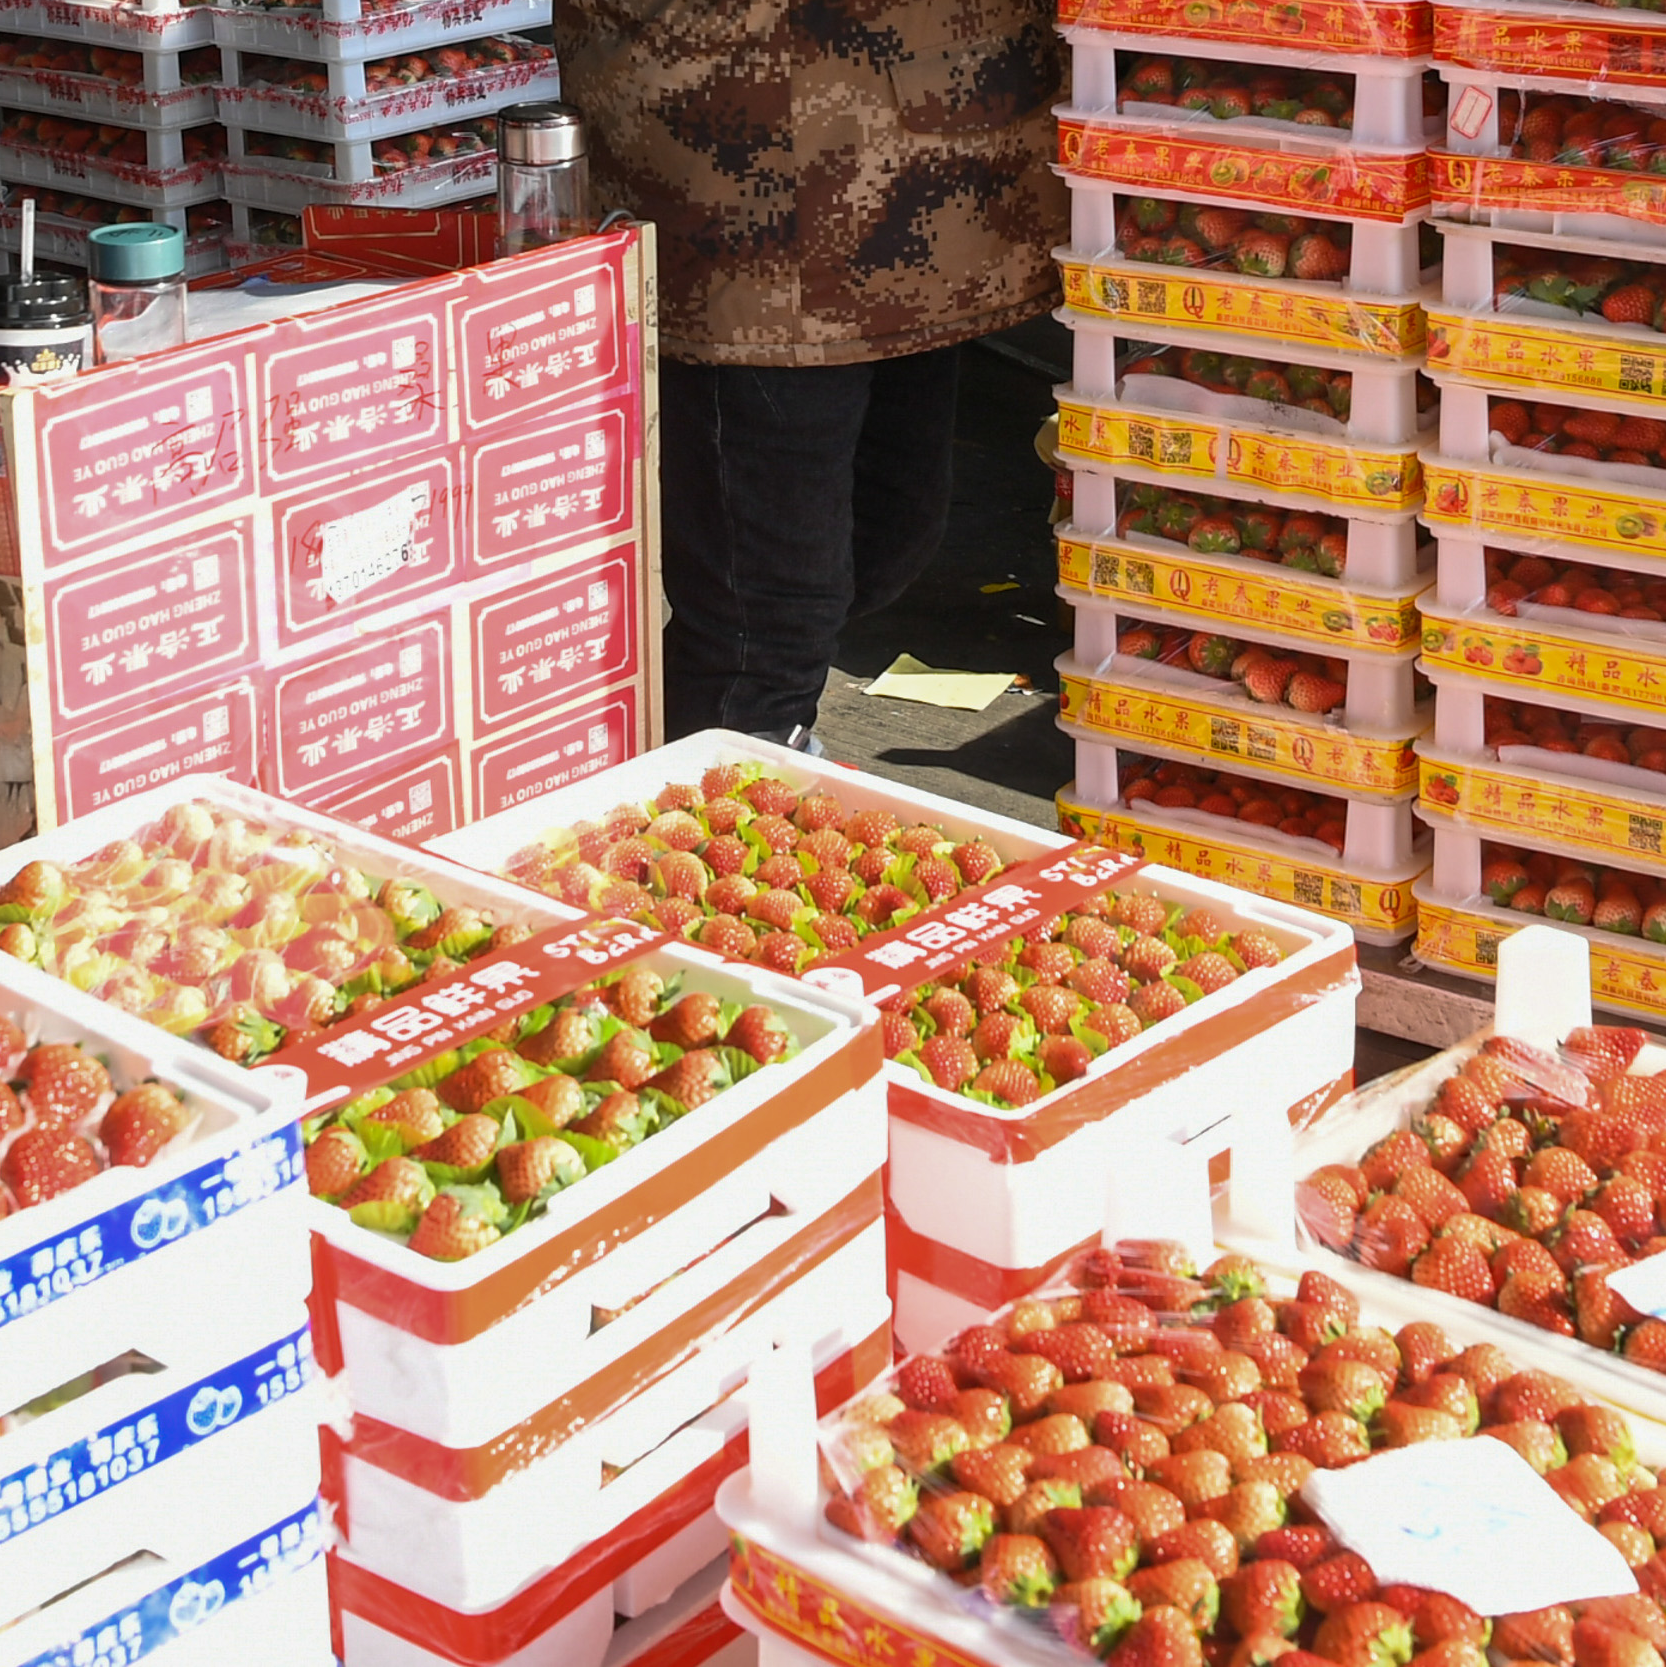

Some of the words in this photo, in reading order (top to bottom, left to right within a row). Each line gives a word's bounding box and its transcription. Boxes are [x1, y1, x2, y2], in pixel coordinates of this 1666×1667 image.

[1182, 286, 1205, 320] Q
[531, 329, 555, 352] HAO
[557, 316, 596, 344] ZHENG
[1470, 334, 1595, 371] 精品水果
[310, 390, 340, 413] GUO
[343, 382, 369, 404] HAO
[74, 461, 92, 482] YE
[95, 448, 130, 475] GUO
[567, 462, 605, 487] ZHENG
[495, 487, 509, 506] YE
[511, 479, 539, 502] GUO
[541, 473, 565, 494] HAO
[492, 486, 606, 538] 正浩果业
[1481, 487, 1606, 521] 老秦果业
[172, 587, 220, 620] ZHENG
[1169, 569, 1191, 602] Q
[1202, 577, 1314, 614] 老秦果业
[103, 615, 137, 643] GUO
[140, 604, 169, 631] HAO
[571, 610, 609, 638] ZHENG
[82, 628, 100, 650] YE
[516, 633, 543, 657] GUO
[545, 624, 569, 647] HAO
[80, 615, 220, 685] 正浩果业
[500, 643, 514, 663] YE
[498, 634, 611, 695] 正浩果业
[351, 692, 377, 716] HAO
[380, 677, 423, 706] ZHENG
[299, 713, 315, 734] YE
[318, 702, 348, 728] GUO
[297, 700, 426, 767] 正浩果业
[1292, 736, 1315, 771] Q
[114, 769, 148, 797] GUO
[151, 757, 180, 784] HAO
[545, 769, 568, 792] HAO
[93, 782, 111, 804] YE
[500, 788, 514, 808] YE
[517, 778, 543, 803] GUO
[1379, 887, 1401, 918] Q
